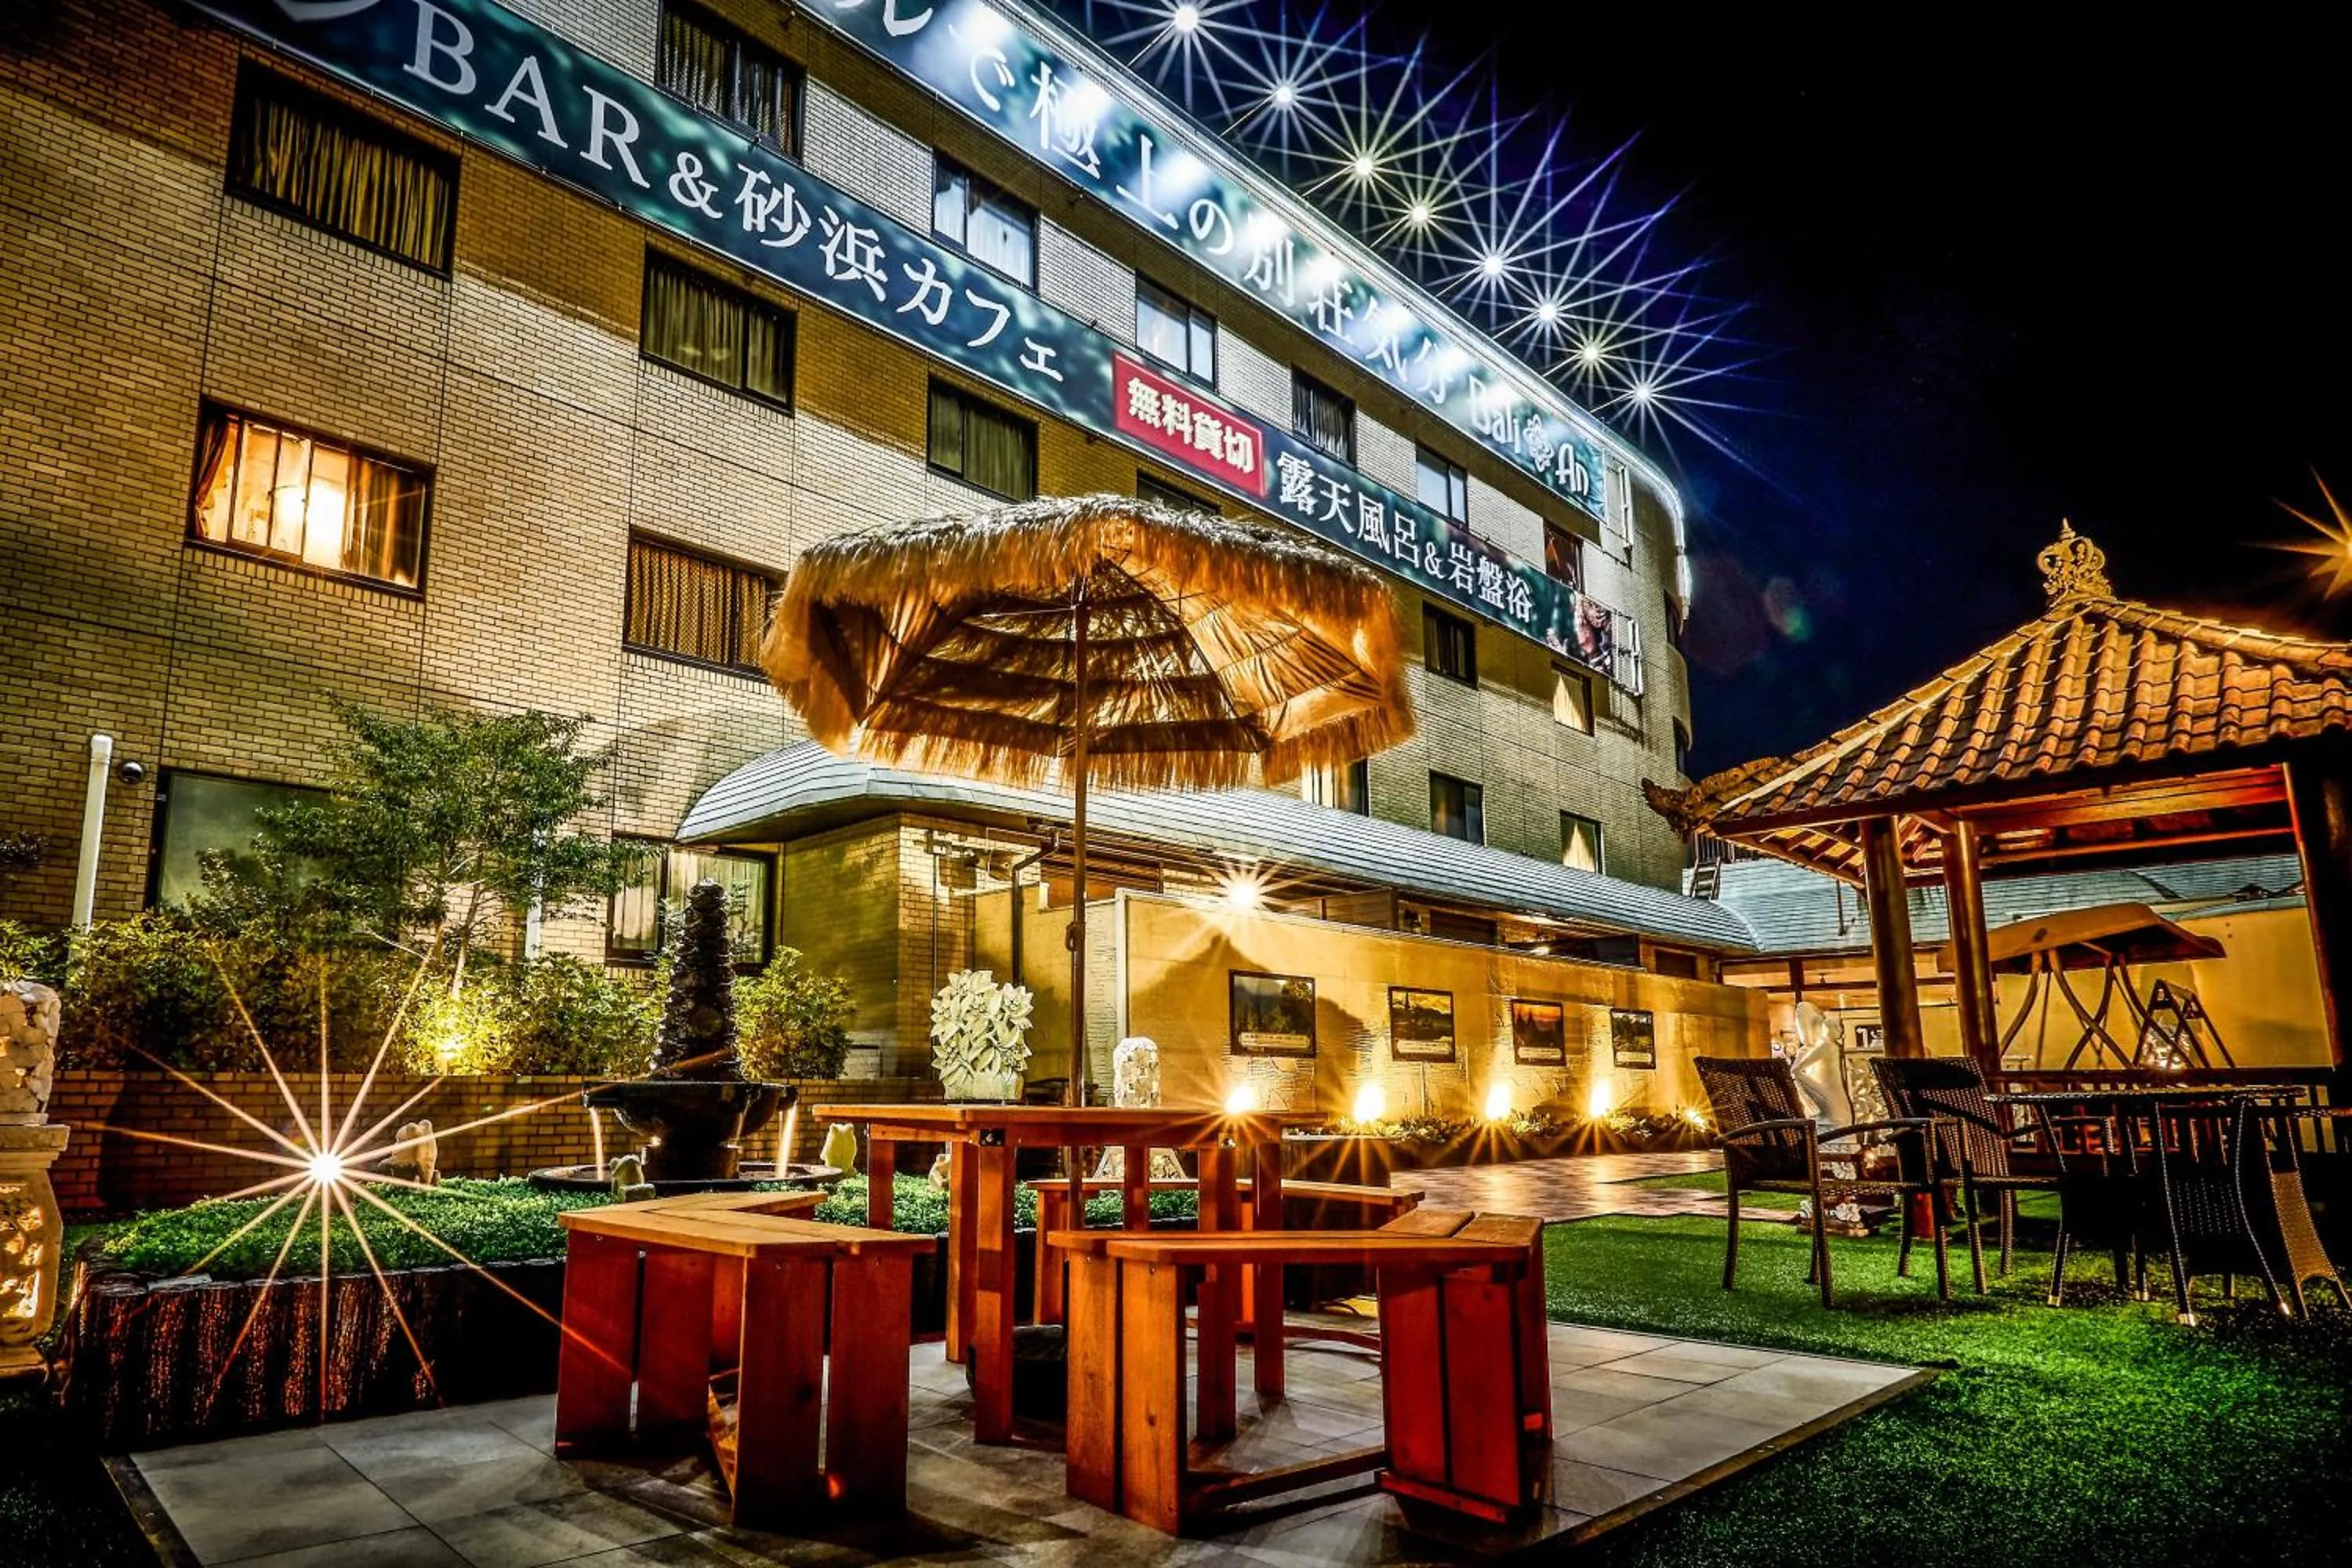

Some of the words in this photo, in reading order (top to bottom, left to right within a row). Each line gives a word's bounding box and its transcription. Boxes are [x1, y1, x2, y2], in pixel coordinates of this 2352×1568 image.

[1127, 377, 1254, 474] 無料貸切
[1555, 443, 1590, 496] An
